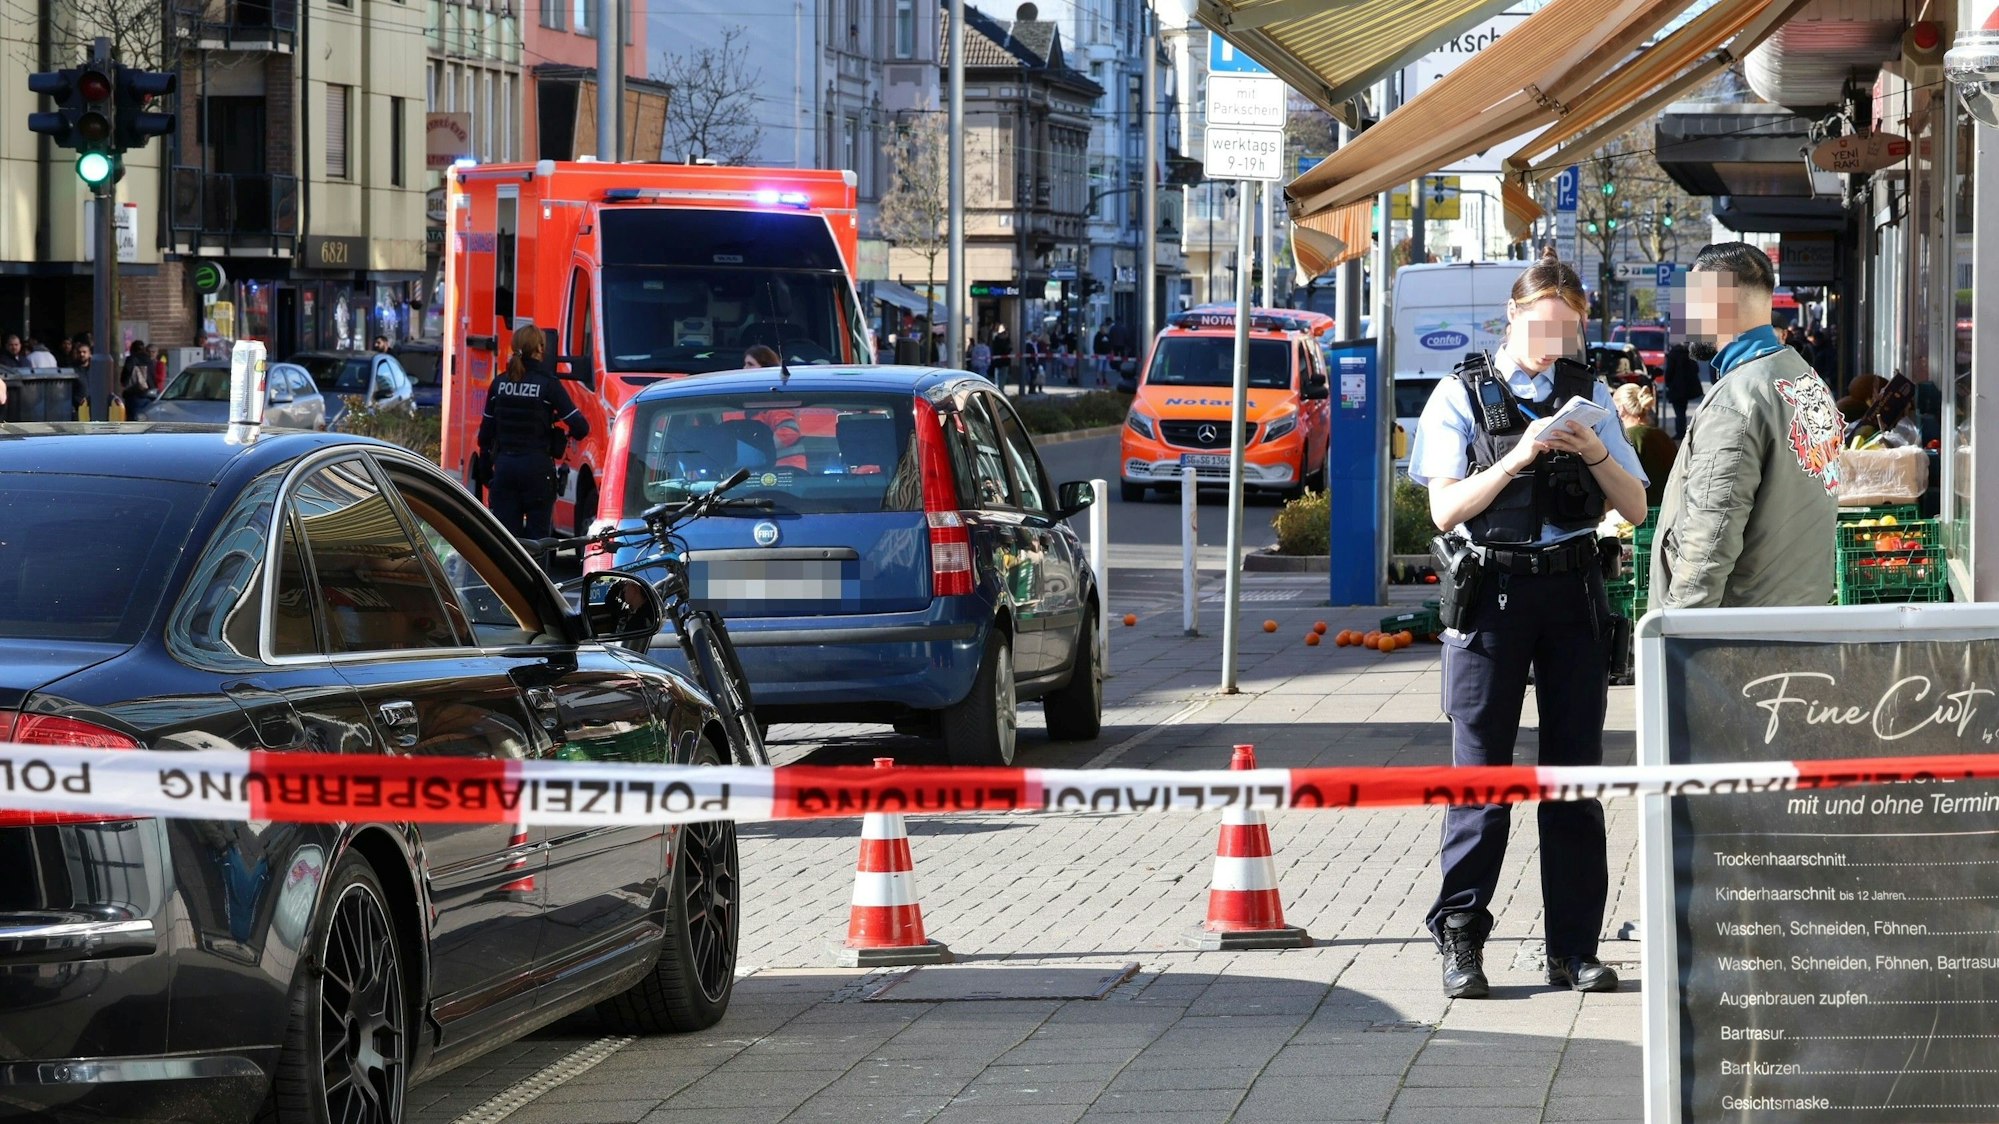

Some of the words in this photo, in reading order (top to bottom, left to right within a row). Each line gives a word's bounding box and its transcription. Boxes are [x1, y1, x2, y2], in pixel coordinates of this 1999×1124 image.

[1237, 88, 1256, 100] mit
[1213, 101, 1279, 116] Parkschein
[1212, 137, 1277, 156] werktags
[1560, 171, 1573, 206] P
[321, 241, 348, 263] 6821
[1201, 315, 1258, 327] NOTAT
[498, 381, 541, 398] POLIZEI
[758, 530, 774, 538] FIAT
[1742, 671, 1870, 745] Fine
[1872, 675, 1996, 742] Cut
[1982, 732, 1994, 744] by
[158, 767, 732, 813] POLIZEIABSPERRUNG
[1787, 797, 1819, 815] mit
[1825, 795, 1864, 815] und
[1871, 794, 1923, 814] ohne
[1930, 792, 1999, 814] Termin
[1714, 851, 1847, 868] Trockenhaarschnitt
[1715, 887, 1836, 902] Kinderhaarschnit
[1839, 890, 1855, 901] bis
[1857, 890, 1869, 901] 12
[1871, 889, 1906, 902] Jahren
[1716, 922, 1786, 938] Waschen,
[1790, 921, 1870, 937] Schneiden,
[1874, 920, 1928, 936] Föhnen
[1718, 957, 1787, 973] Waschen,
[1791, 956, 1871, 973] Schneiden,
[1875, 955, 1933, 972] Föhnen,
[1720, 992, 1815, 1009] Augenbrauen
[1819, 991, 1868, 1008] zupfen
[1720, 1026, 1785, 1041] Bartrasur
[1721, 1061, 1751, 1076] Bart
[1753, 1060, 1801, 1076] kürzen
[1722, 1095, 1830, 1111] Gesichtsmaske
